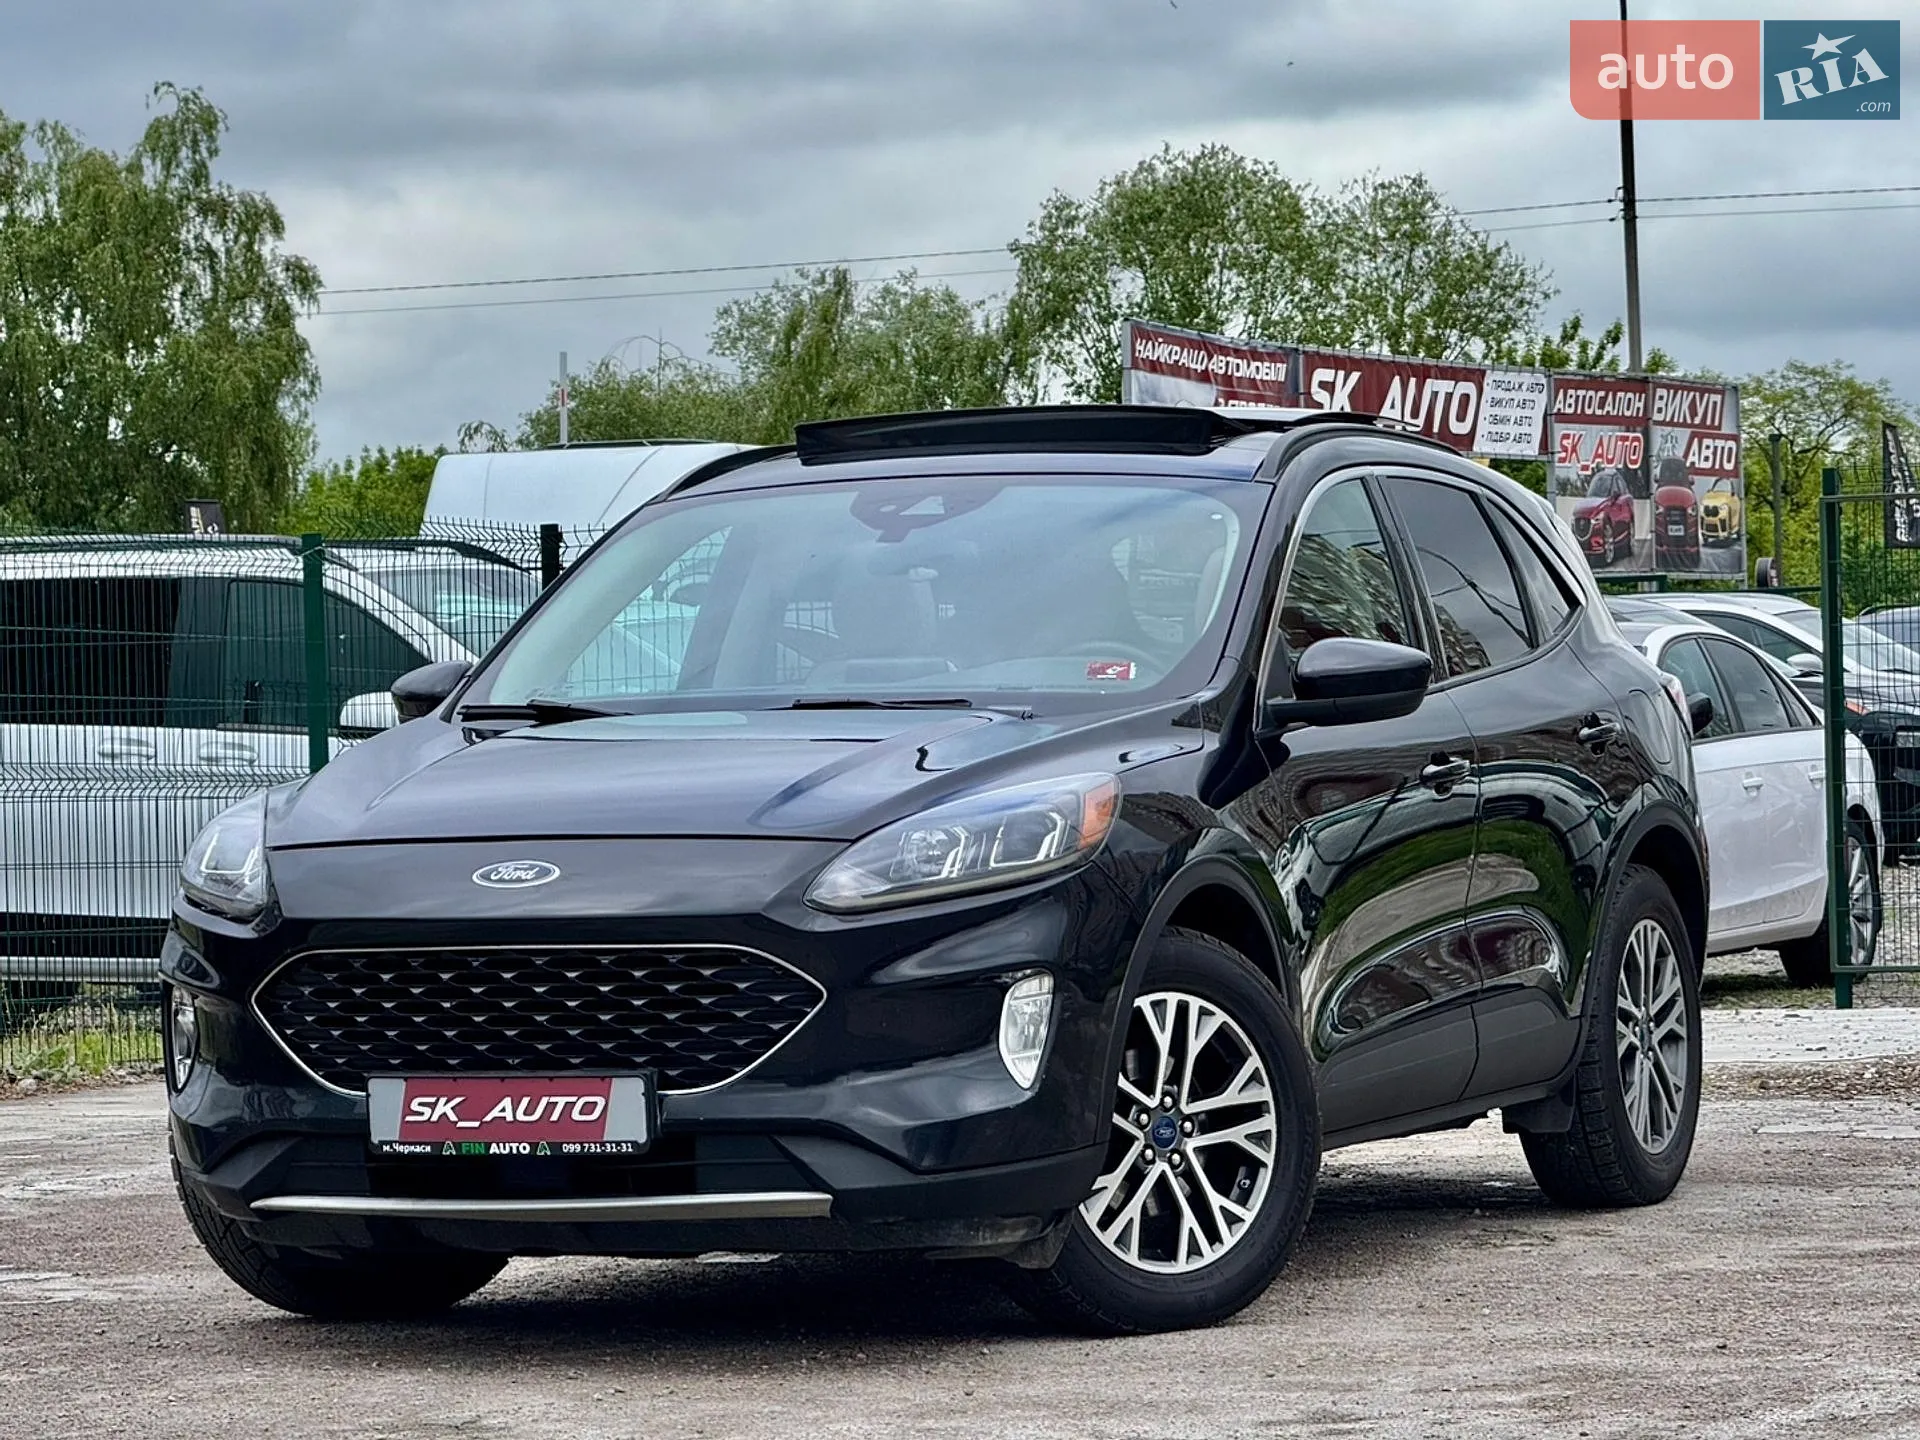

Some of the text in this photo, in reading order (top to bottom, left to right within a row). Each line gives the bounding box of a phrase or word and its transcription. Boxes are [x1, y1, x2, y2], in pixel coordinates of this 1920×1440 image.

[1208, 354, 1288, 382] АВТОМОБІЛІ
[1490, 379, 1545, 394] ПРОДАЖ АВТО
[1489, 396, 1536, 410] ВИКУП АВТО
[1554, 388, 1646, 418] АВТОСАЛОН
[1653, 387, 1722, 427] ВИКУП
[1512, 415, 1533, 427] АВТО
[1511, 432, 1532, 444] АВТО
[1556, 430, 1644, 475] SK_AUTO
[1685, 437, 1737, 471] АВТО
[490, 864, 540, 880] Ford
[404, 1096, 606, 1128] SK_AUTO
[462, 1143, 485, 1154] FIN
[489, 1142, 530, 1155] AUTO
[562, 1143, 633, 1153] 099 731-31-31
